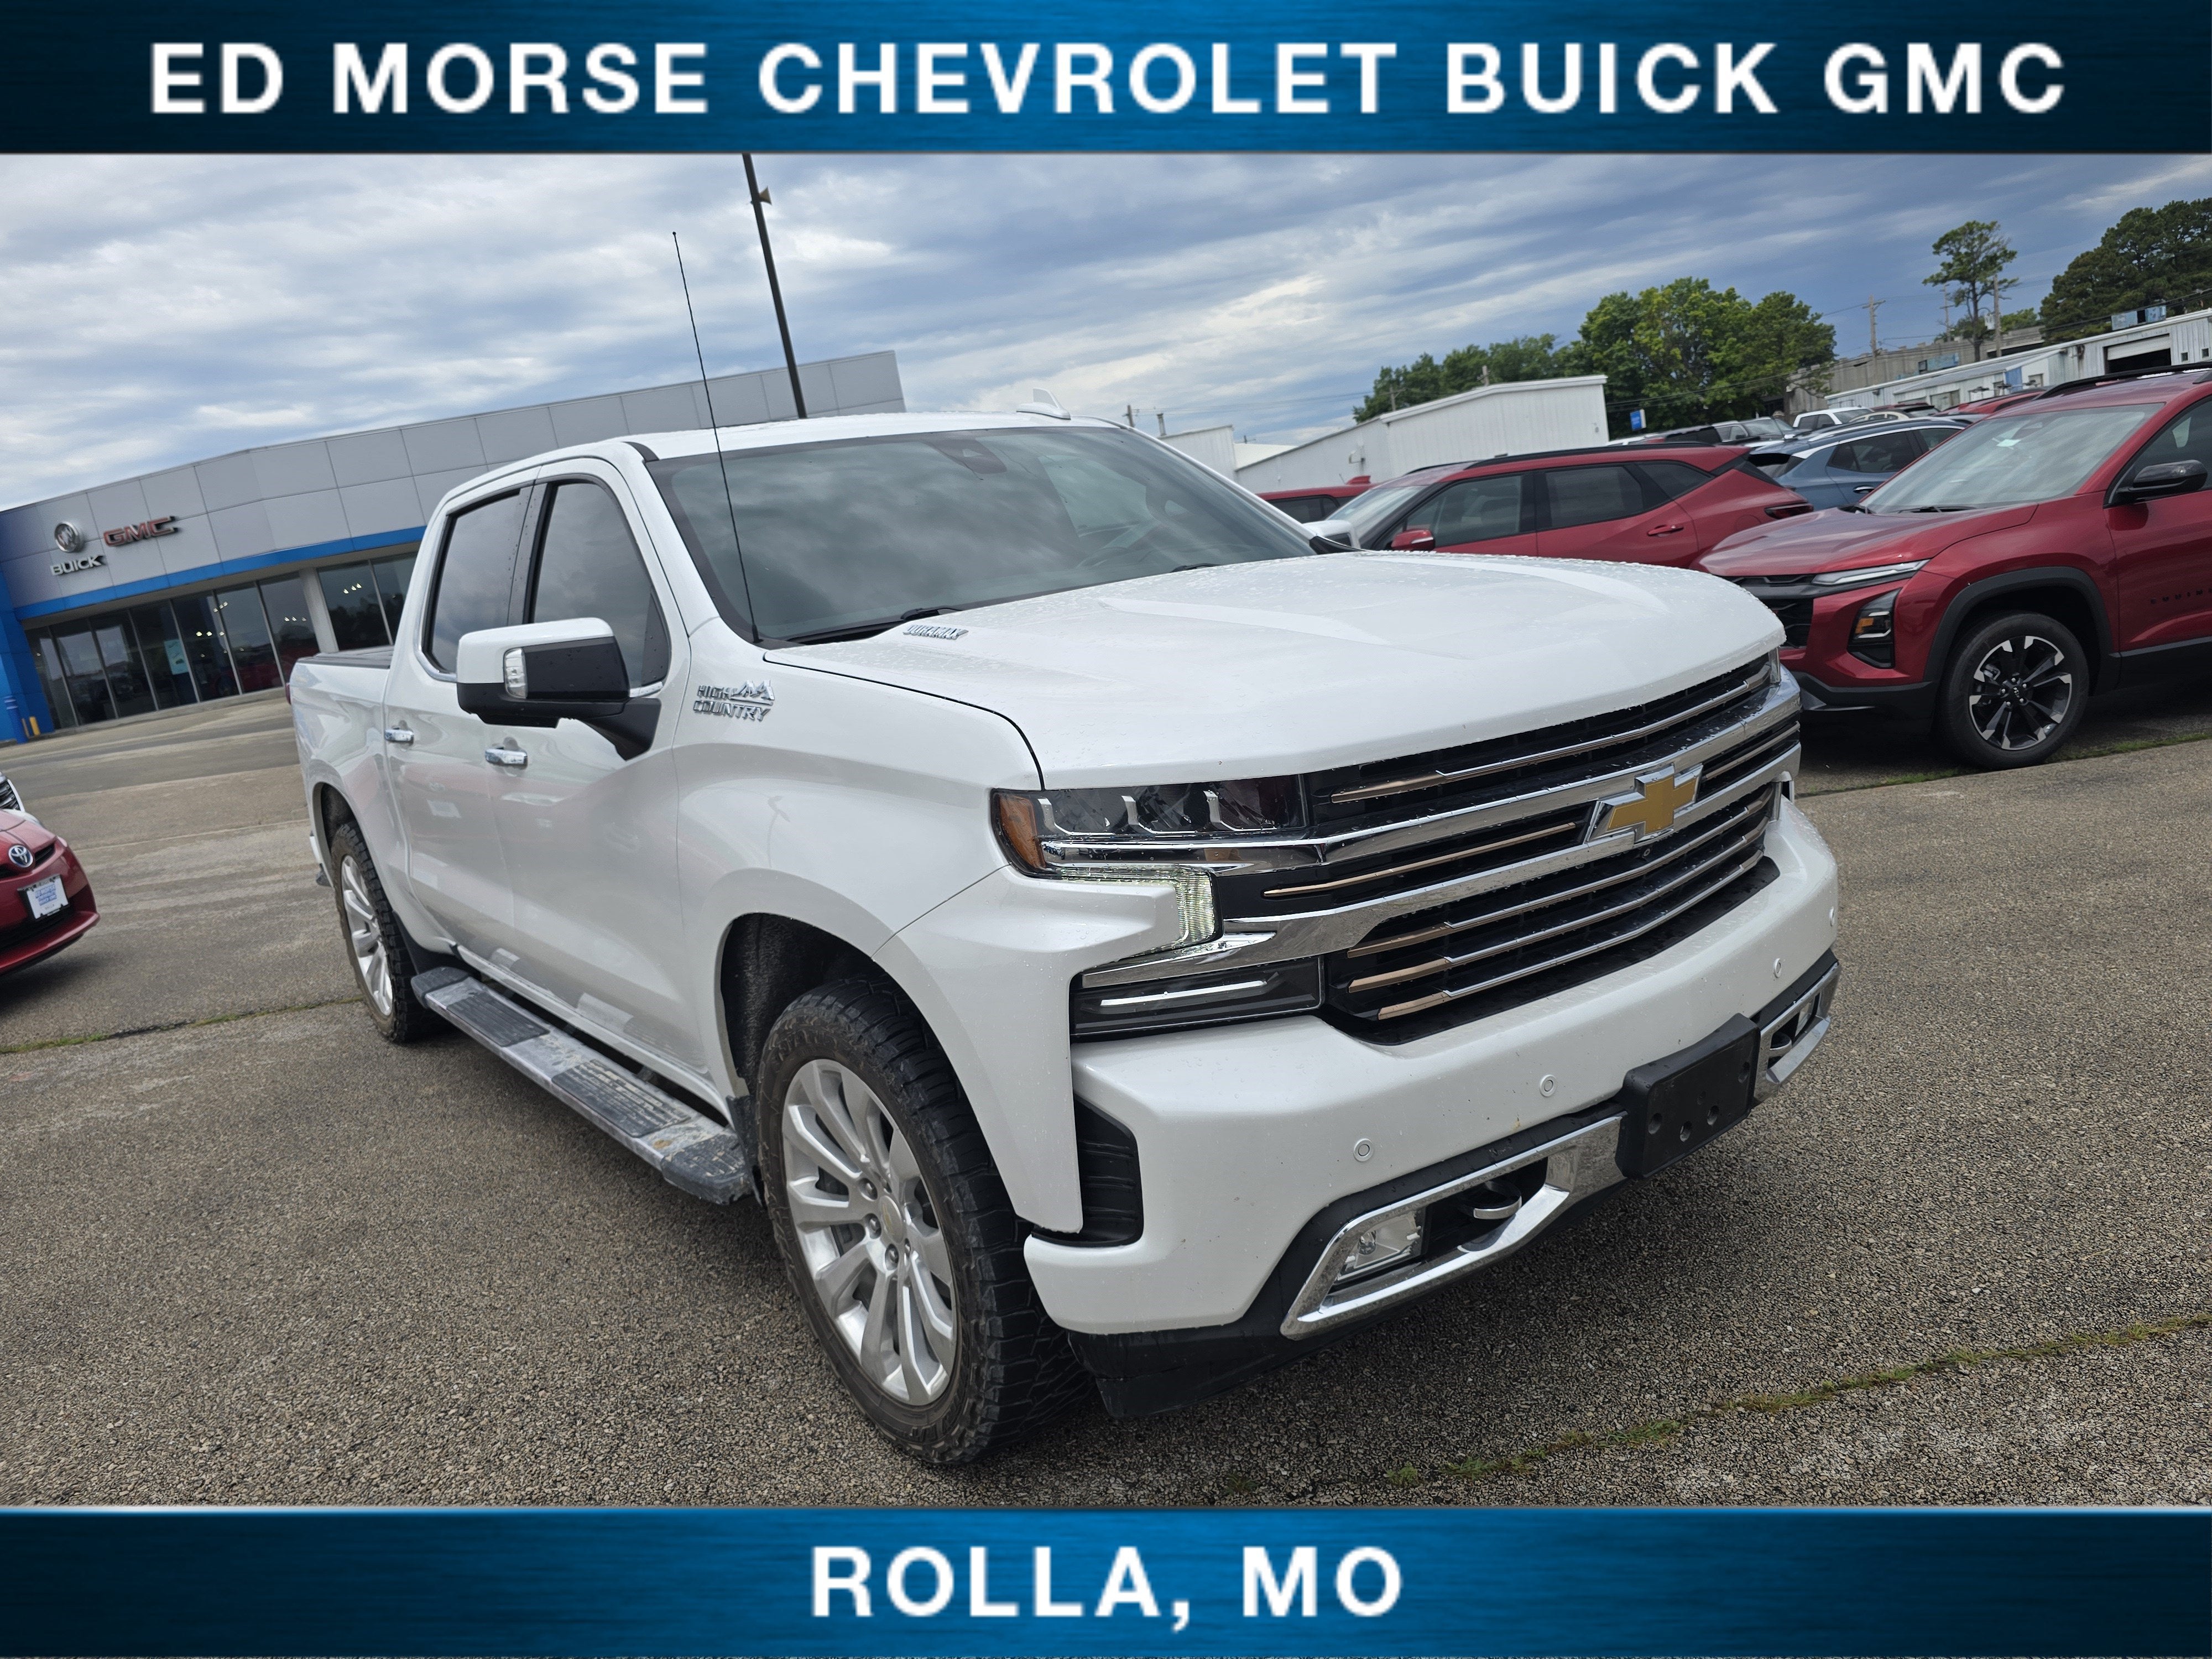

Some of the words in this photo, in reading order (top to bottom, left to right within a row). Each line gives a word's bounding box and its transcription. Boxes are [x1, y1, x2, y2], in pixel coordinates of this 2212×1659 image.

[103, 516, 178, 546] GMC
[50, 555, 104, 576] BUICK
[902, 624, 969, 640] DURAMAX
[697, 684, 738, 700] HIGH
[693, 700, 771, 722] COUNTRY
